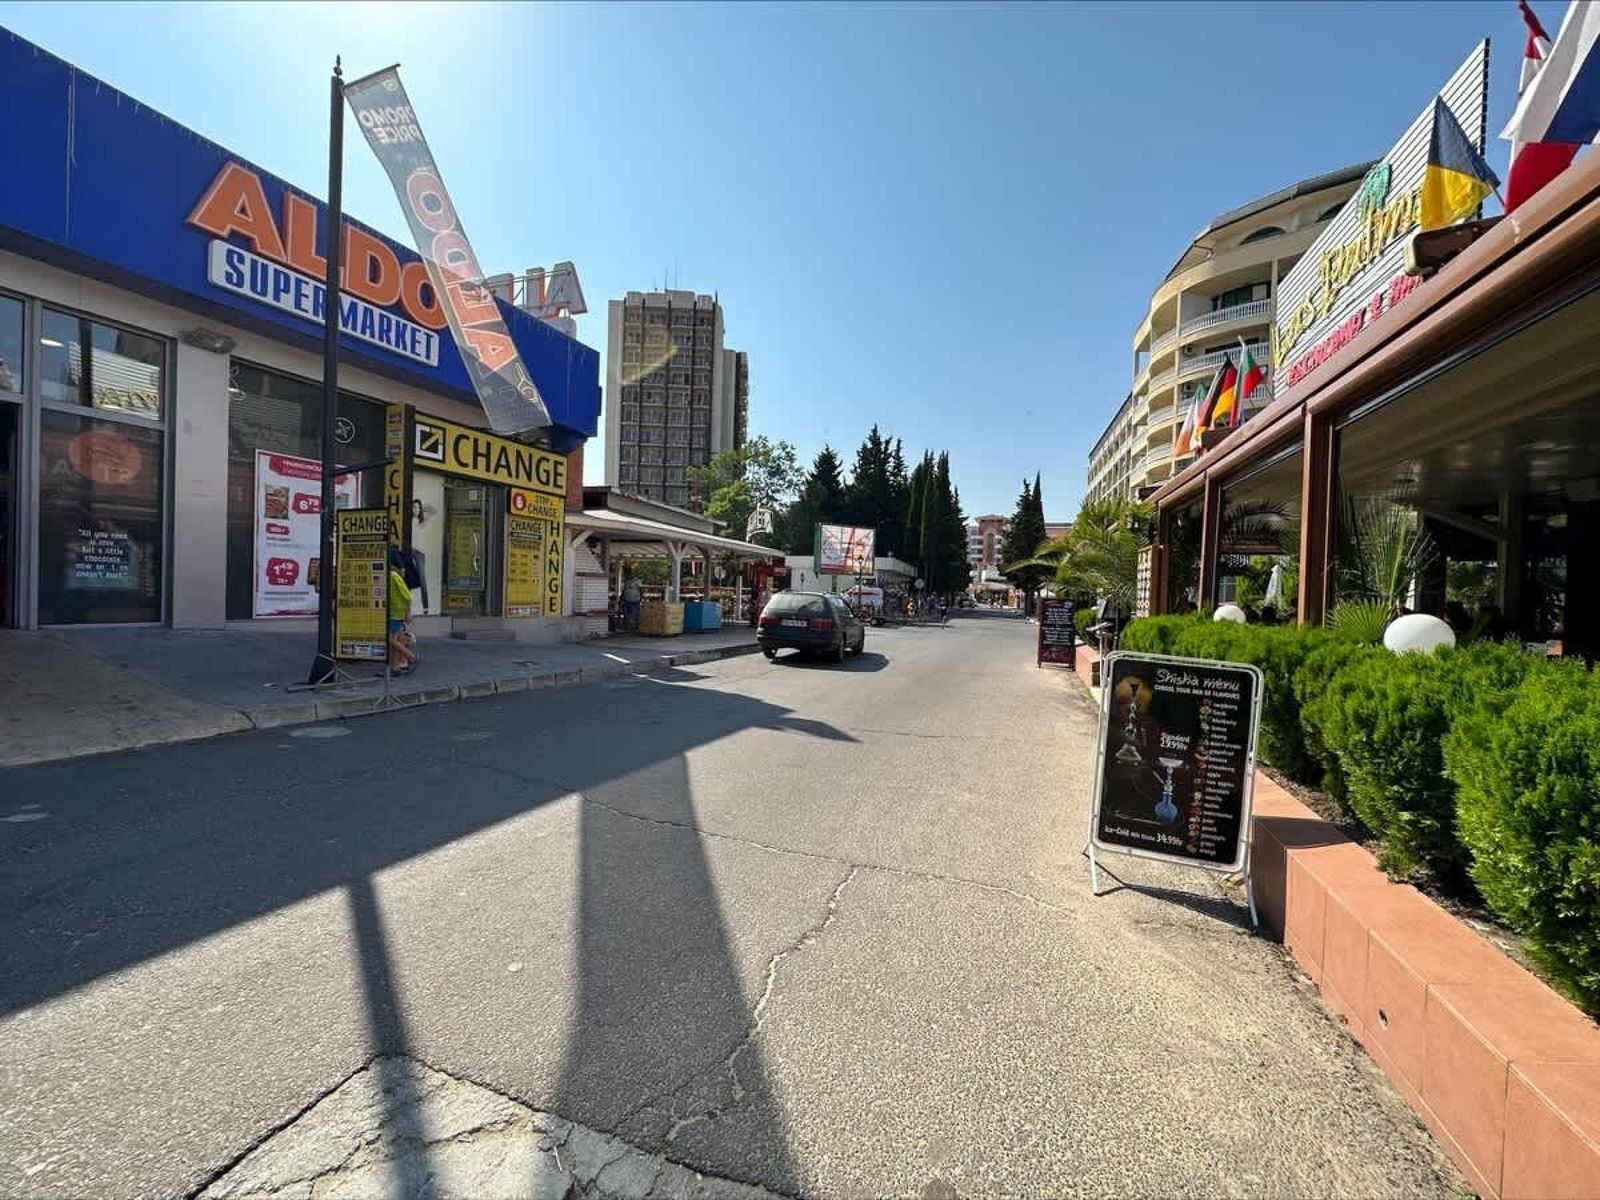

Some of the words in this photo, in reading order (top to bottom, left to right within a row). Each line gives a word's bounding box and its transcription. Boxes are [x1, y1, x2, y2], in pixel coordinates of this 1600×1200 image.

[187, 160, 450, 330] ALDO
[224, 247, 435, 362] SUPERMARKET
[452, 433, 565, 490] CHANGE
[342, 515, 388, 533] CHANGE
[511, 519, 544, 534] CHANGE
